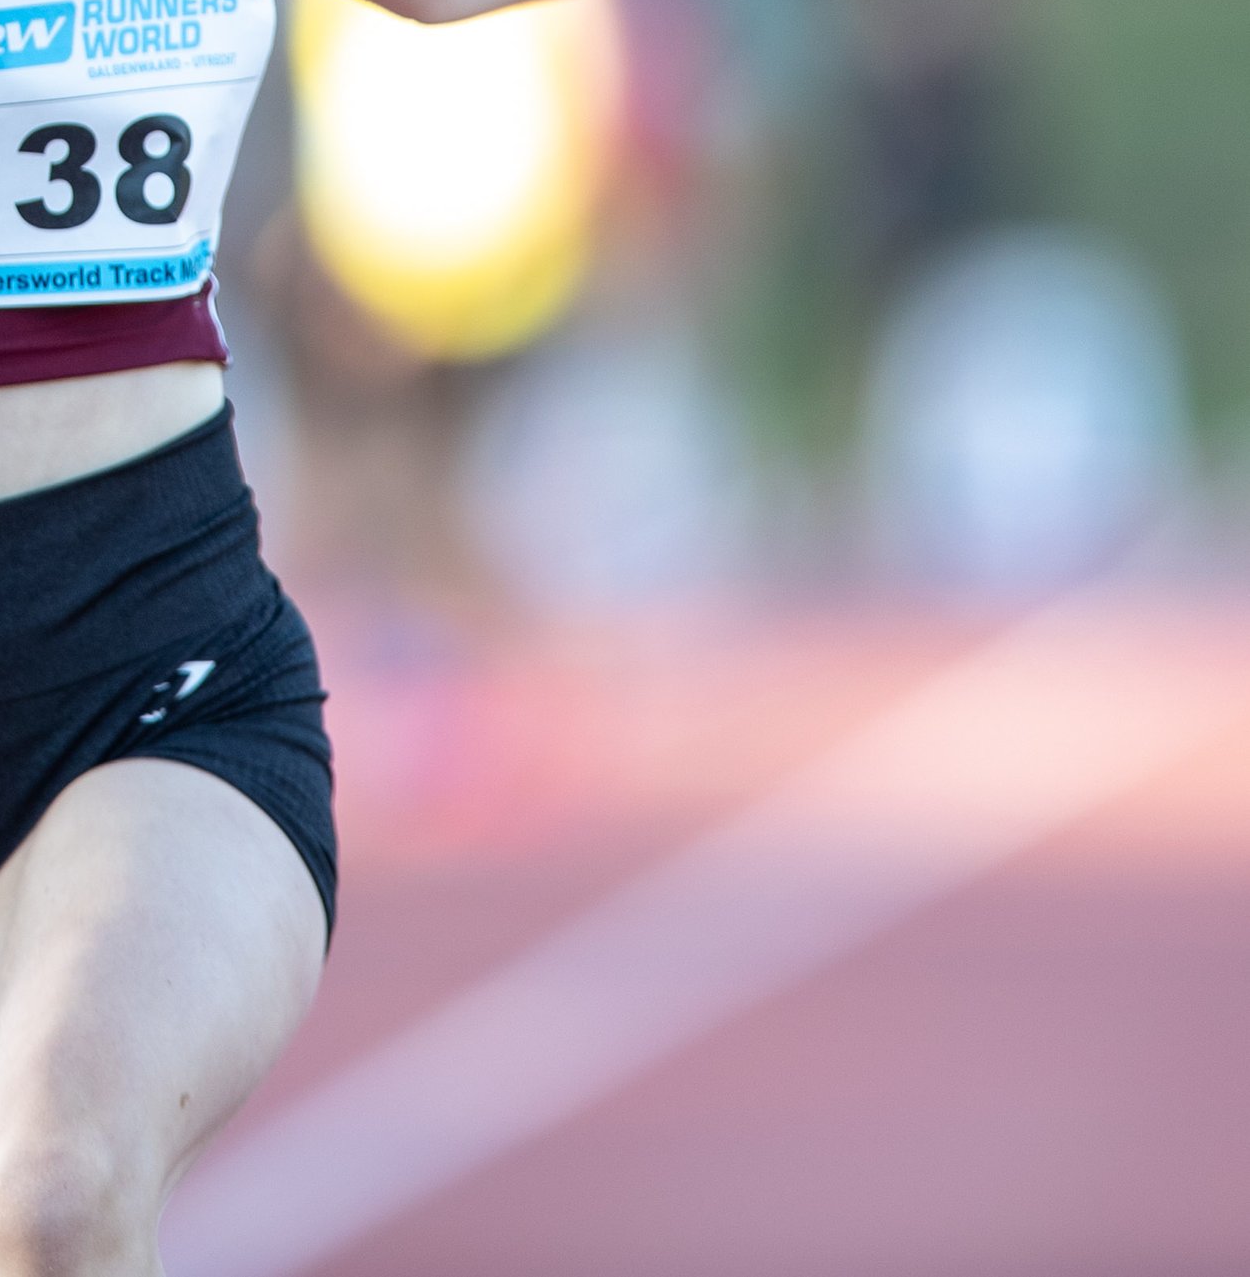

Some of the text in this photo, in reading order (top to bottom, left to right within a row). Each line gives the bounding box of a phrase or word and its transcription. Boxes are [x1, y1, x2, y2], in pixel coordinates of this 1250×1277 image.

[82, 20, 201, 59] WORLD
[15, 113, 192, 230] 38
[111, 260, 176, 285] Track
